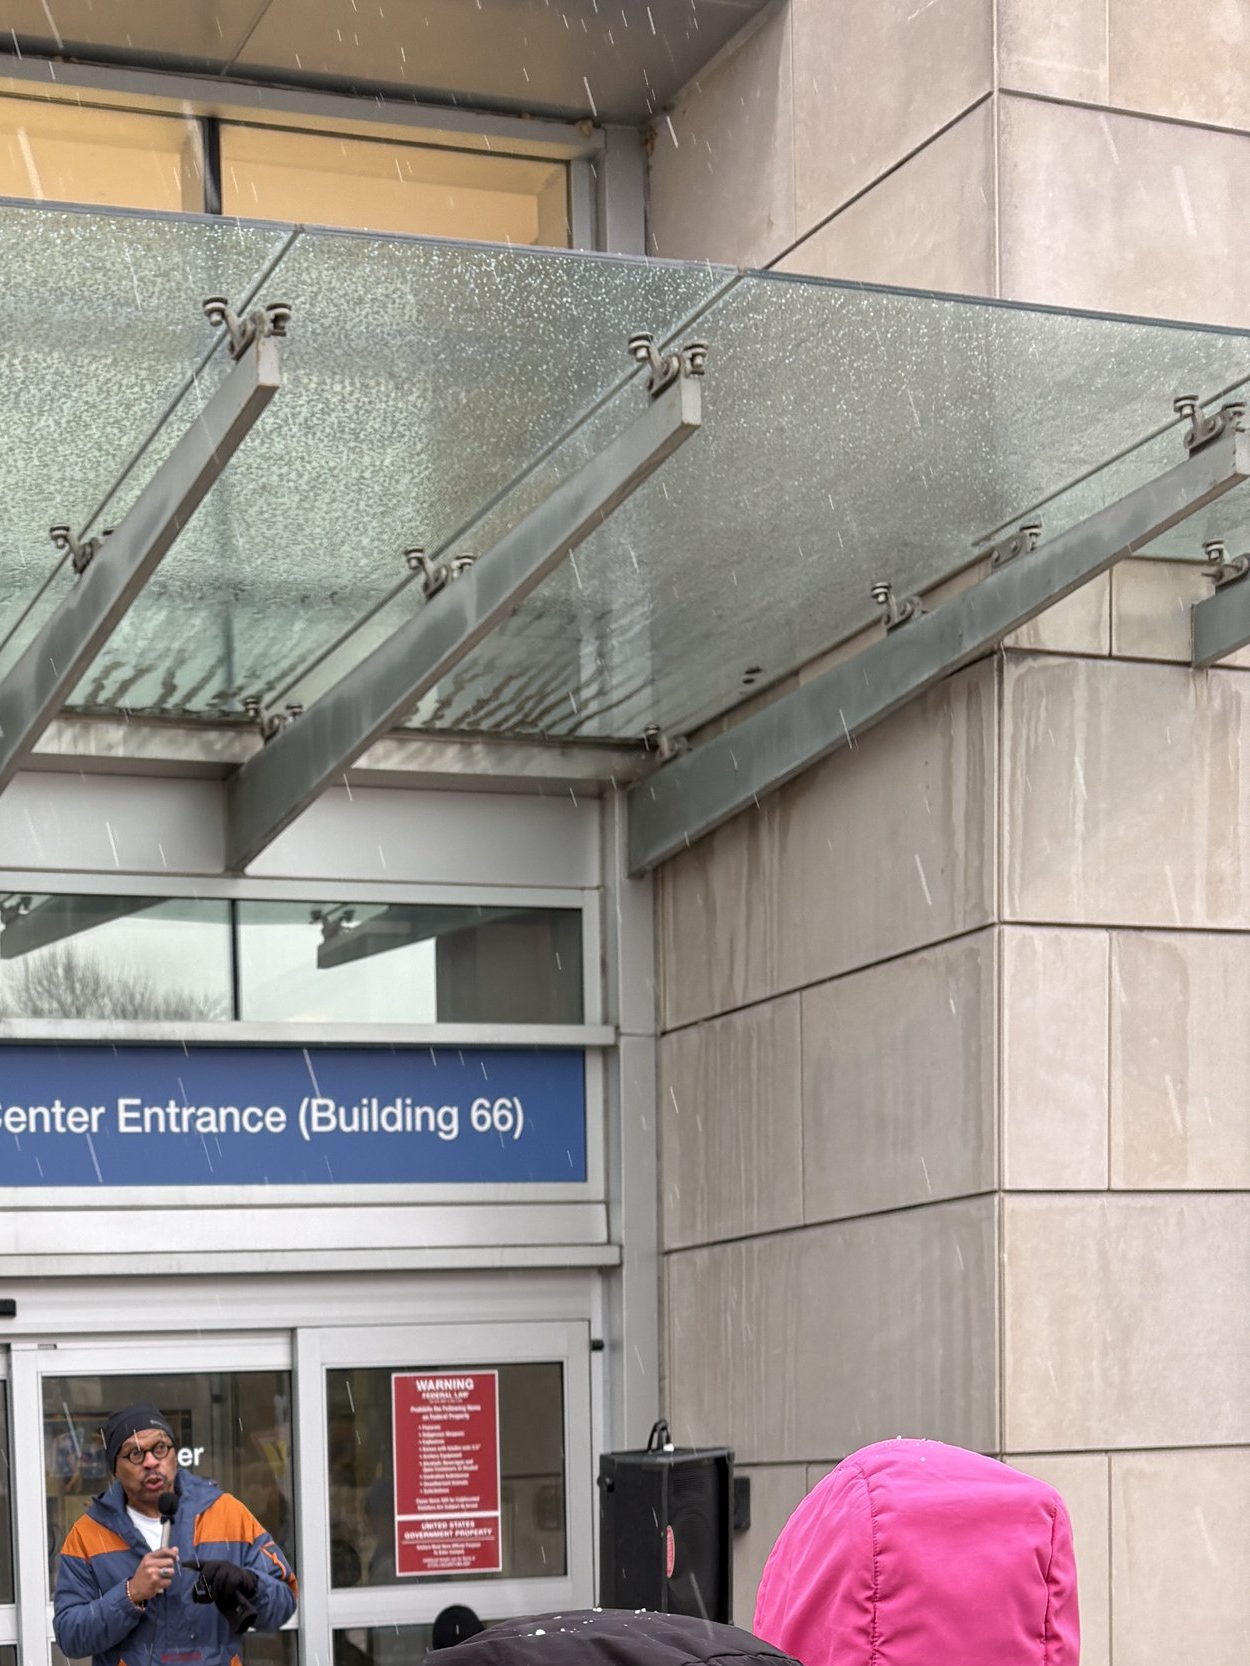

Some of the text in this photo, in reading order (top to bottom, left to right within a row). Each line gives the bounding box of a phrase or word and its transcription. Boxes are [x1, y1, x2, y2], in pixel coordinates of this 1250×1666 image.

[118, 1099, 286, 1133] Entrance
[299, 1097, 458, 1140] (Building
[471, 1098, 523, 1138] 66)
[415, 1378, 474, 1391] WARNING
[421, 1522, 447, 1530] UNITED
[404, 1529, 492, 1540] GOVERNMENT PROPERTY
